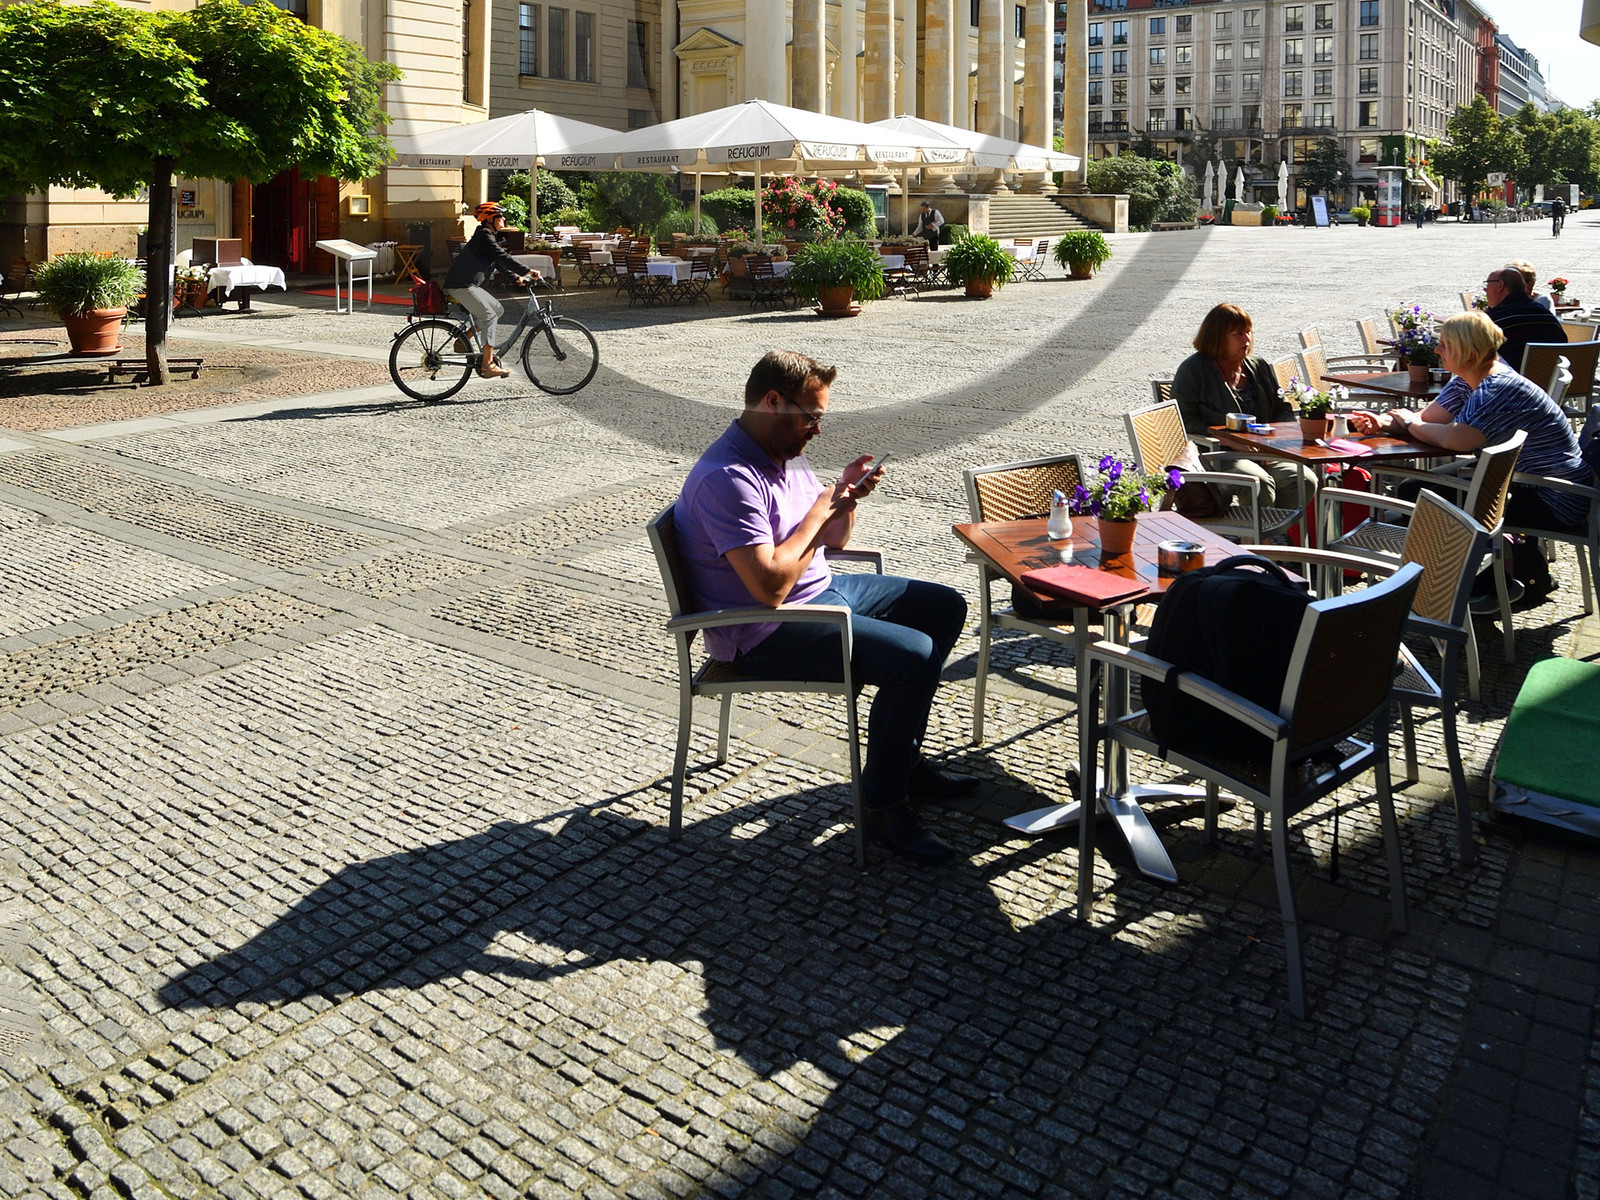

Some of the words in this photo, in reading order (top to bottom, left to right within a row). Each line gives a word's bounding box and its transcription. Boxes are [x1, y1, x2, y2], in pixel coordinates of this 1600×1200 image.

[728, 145, 770, 160] REFUGIUM
[813, 144, 848, 159] REFUGIUM
[419, 158, 451, 166] RESTAURANT
[487, 157, 519, 167] REFUGIUM
[561, 156, 596, 167] REFUGIUM
[637, 155, 680, 165] RESTAURANT
[177, 209, 205, 219] UGIUM
